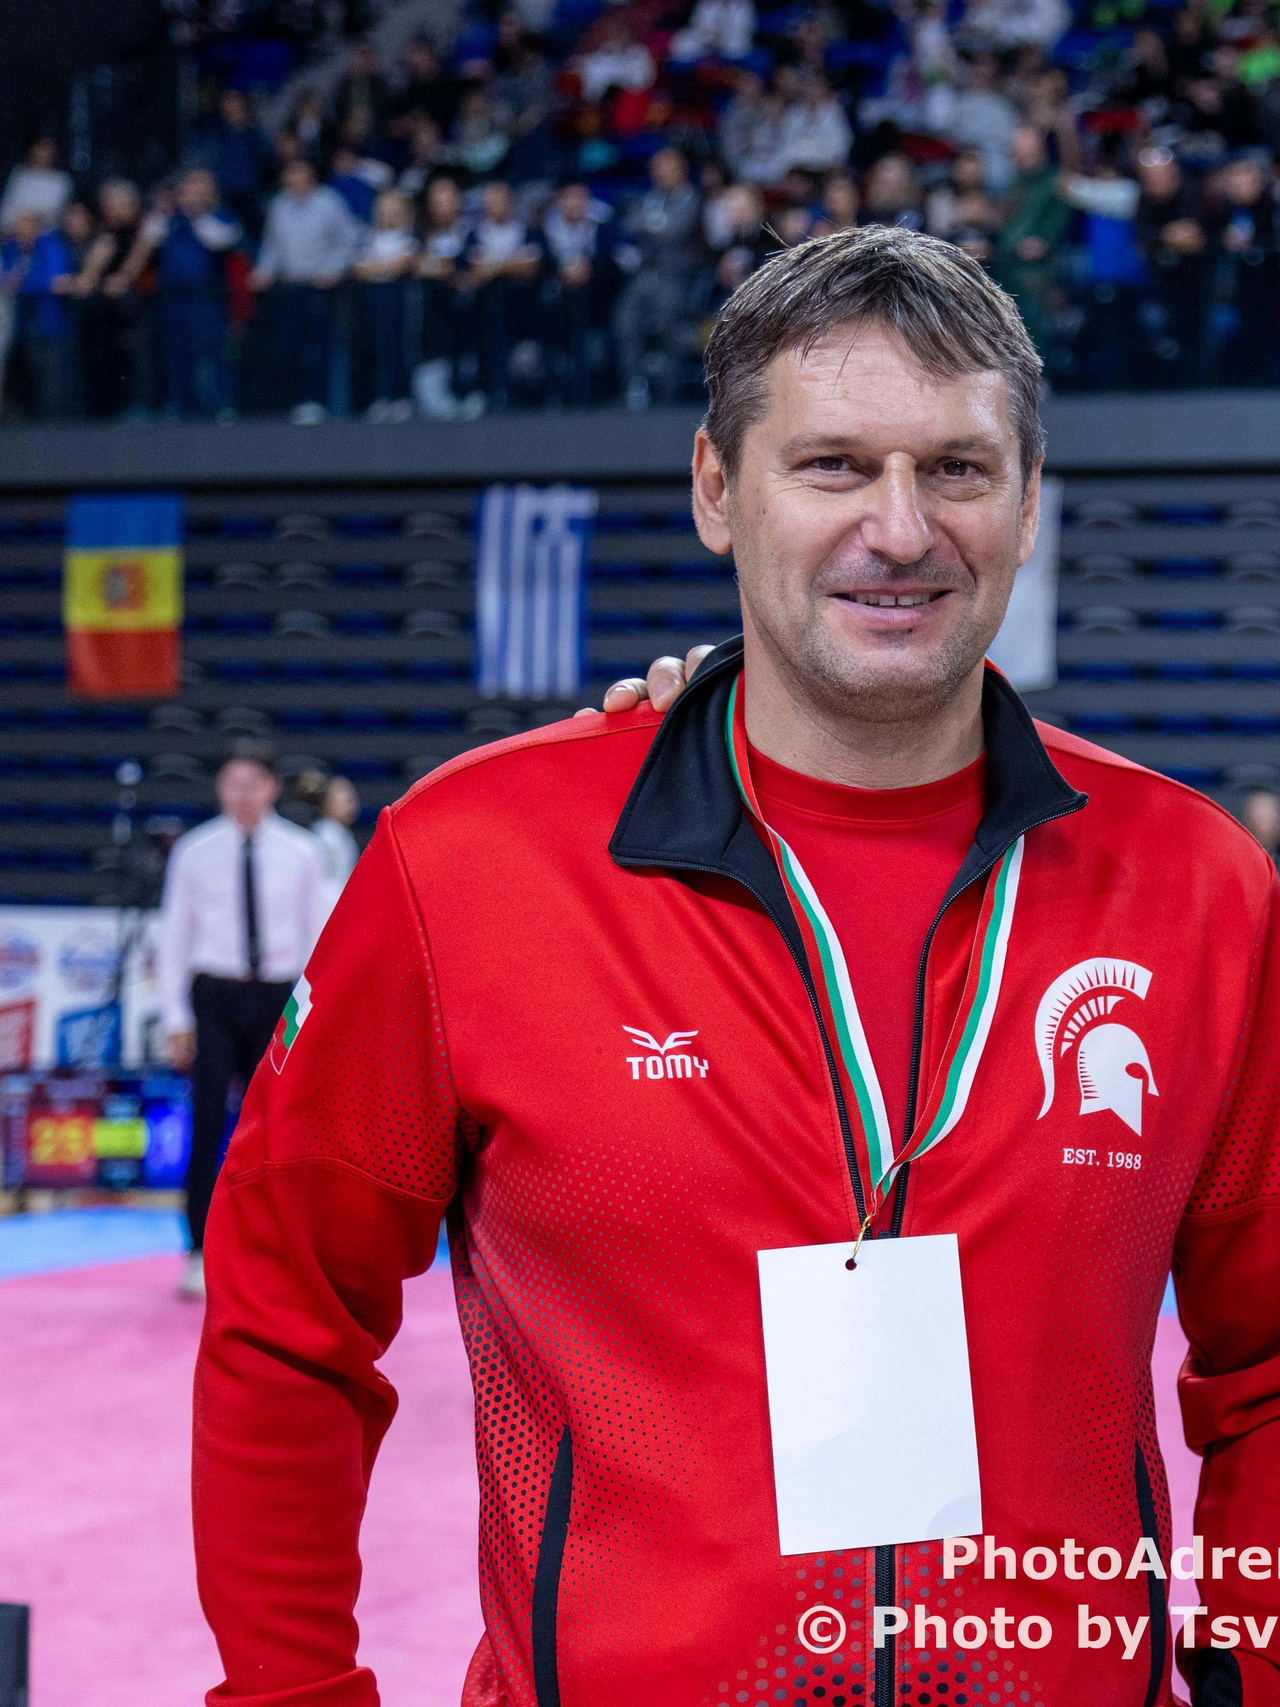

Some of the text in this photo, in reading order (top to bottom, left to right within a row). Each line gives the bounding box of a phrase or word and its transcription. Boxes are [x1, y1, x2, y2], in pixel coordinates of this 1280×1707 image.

[626, 1054, 709, 1080] TOMY
[1062, 1147, 1142, 1170] EST. 1988
